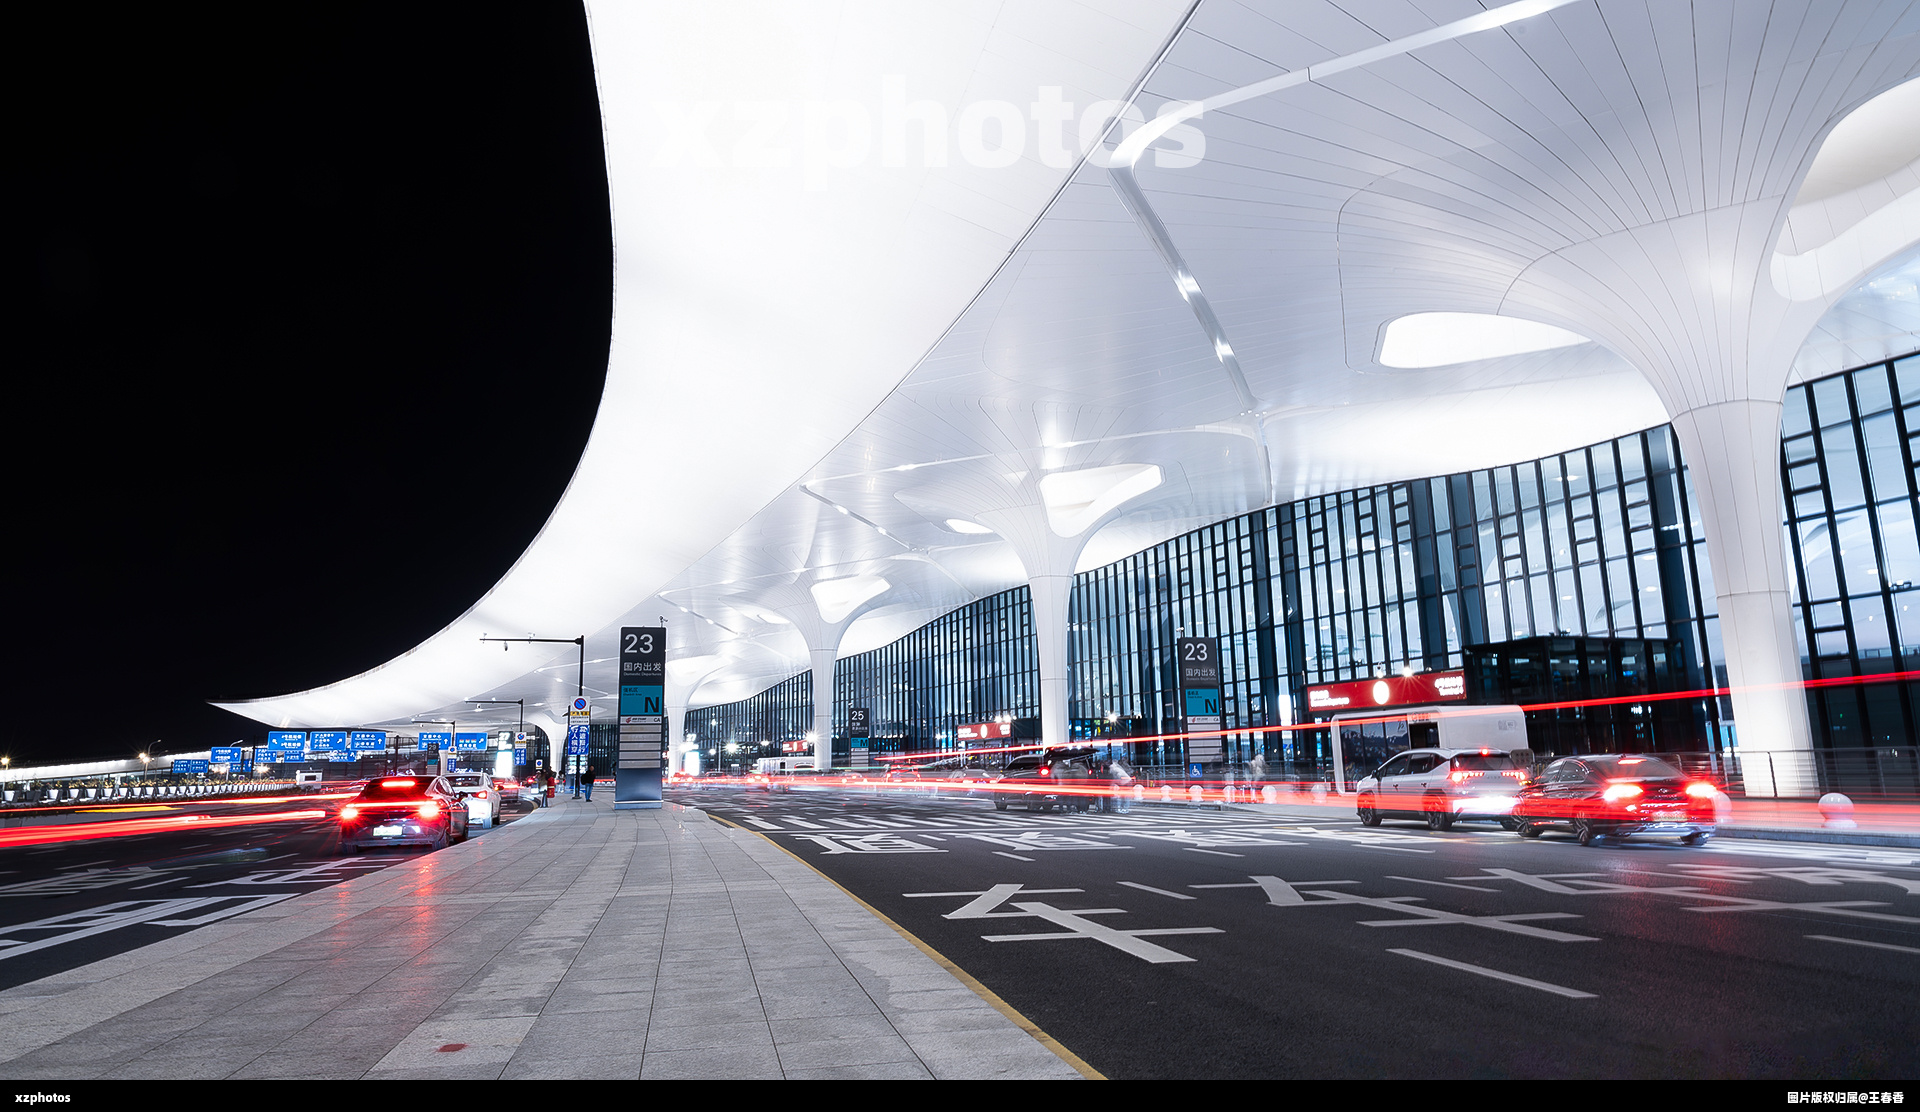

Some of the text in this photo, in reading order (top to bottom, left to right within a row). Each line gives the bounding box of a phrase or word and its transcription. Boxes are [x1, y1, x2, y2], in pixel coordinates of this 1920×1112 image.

[624, 634, 653, 653] 23
[1184, 643, 1208, 661] 23
[623, 662, 661, 671] 国内出发
[1185, 668, 1216, 677] 国内出发
[644, 697, 660, 713] N
[1204, 698, 1218, 714] N
[851, 710, 864, 720] 25
[499, 732, 510, 740] 27
[790, 833, 949, 855] 道
[183, 856, 404, 888] 走
[1187, 875, 1602, 942] 车
[902, 883, 1226, 964] 车
